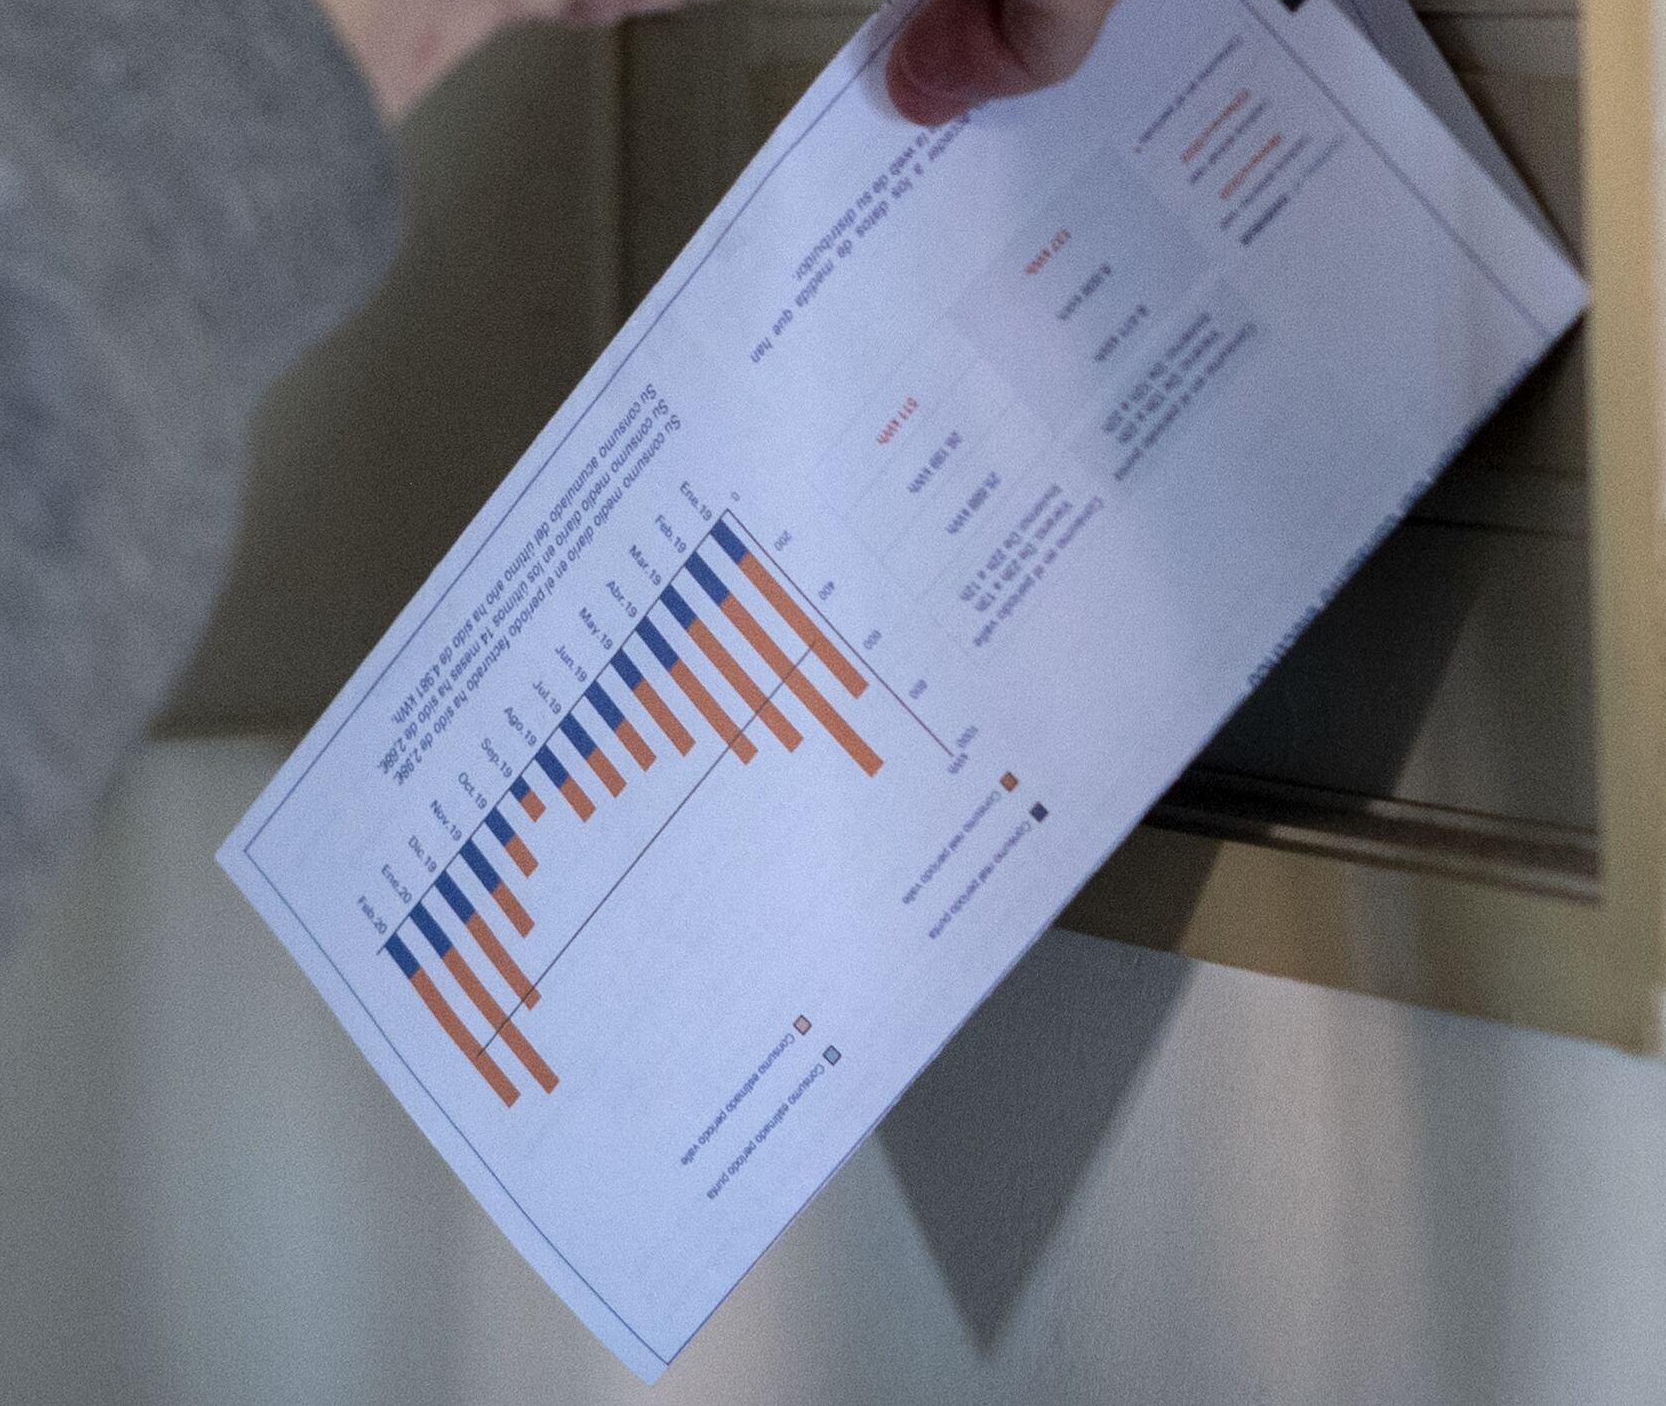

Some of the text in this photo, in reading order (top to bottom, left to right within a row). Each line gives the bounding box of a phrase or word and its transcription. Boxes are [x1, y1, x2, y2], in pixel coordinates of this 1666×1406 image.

[856, 192, 872, 210] su
[872, 175, 888, 193] de
[891, 178, 912, 199] los
[855, 201, 888, 237] datos
[793, 209, 856, 280] distribuidor.
[837, 239, 852, 258] de
[795, 259, 834, 307] medida
[773, 309, 793, 336] que
[751, 338, 773, 363] han
[652, 399, 668, 418] Su
[664, 414, 681, 433] Su
[611, 417, 653, 473] consumo
[623, 432, 665, 488] consumo
[581, 473, 611, 511] medio
[594, 487, 623, 526] medio
[679, 481, 712, 521] Ene.19
[555, 510, 582, 546] diario
[655, 514, 686, 553] Feb.19
[774, 530, 792, 551] 200
[1056, 496, 1103, 549] Consumo
[392, 384, 657, 723] Su consumo acumulado del último año ha sido de 4.981 kWh.
[543, 545, 555, 563] en
[567, 526, 594, 562] diario
[527, 562, 544, 583] los
[554, 560, 567, 578] en
[629, 545, 661, 586] Mar.19
[492, 581, 527, 627] últimos
[544, 577, 555, 595] el
[606, 581, 637, 618] Abr.19
[819, 581, 835, 600] 400
[480, 628, 493, 645] 14
[579, 607, 613, 650] May.19
[450, 642, 480, 681] meses
[467, 636, 510, 691] facturado
[555, 645, 587, 682] Jun.19
[438, 680, 452, 697] ha
[453, 690, 468, 708] ha
[532, 681, 561, 714] Jul.19
[418, 696, 439, 723] sido
[434, 706, 454, 734] sido
[504, 707, 537, 746] Ago.19
[404, 722, 417, 740] de
[420, 733, 433, 751] de
[481, 738, 512, 778] Sep.19
[458, 772, 487, 809] Oct.19
[430, 800, 462, 841] Nov.19
[963, 791, 1000, 832] Consumo
[408, 835, 437, 873] Dic.19
[949, 833, 964, 851] real
[993, 821, 1031, 863] Consumo
[381, 864, 412, 904] Ene.20
[978, 864, 994, 882] real
[902, 884, 922, 904] valle
[358, 896, 387, 934] Feb.20
[928, 912, 951, 939] punta
[758, 1033, 795, 1074] Consumo
[725, 1073, 759, 1112] estimado
[788, 1064, 824, 1105] Consumo
[755, 1103, 789, 1143] estimado
[681, 1144, 699, 1165] valle
[707, 1172, 729, 1199] punta
